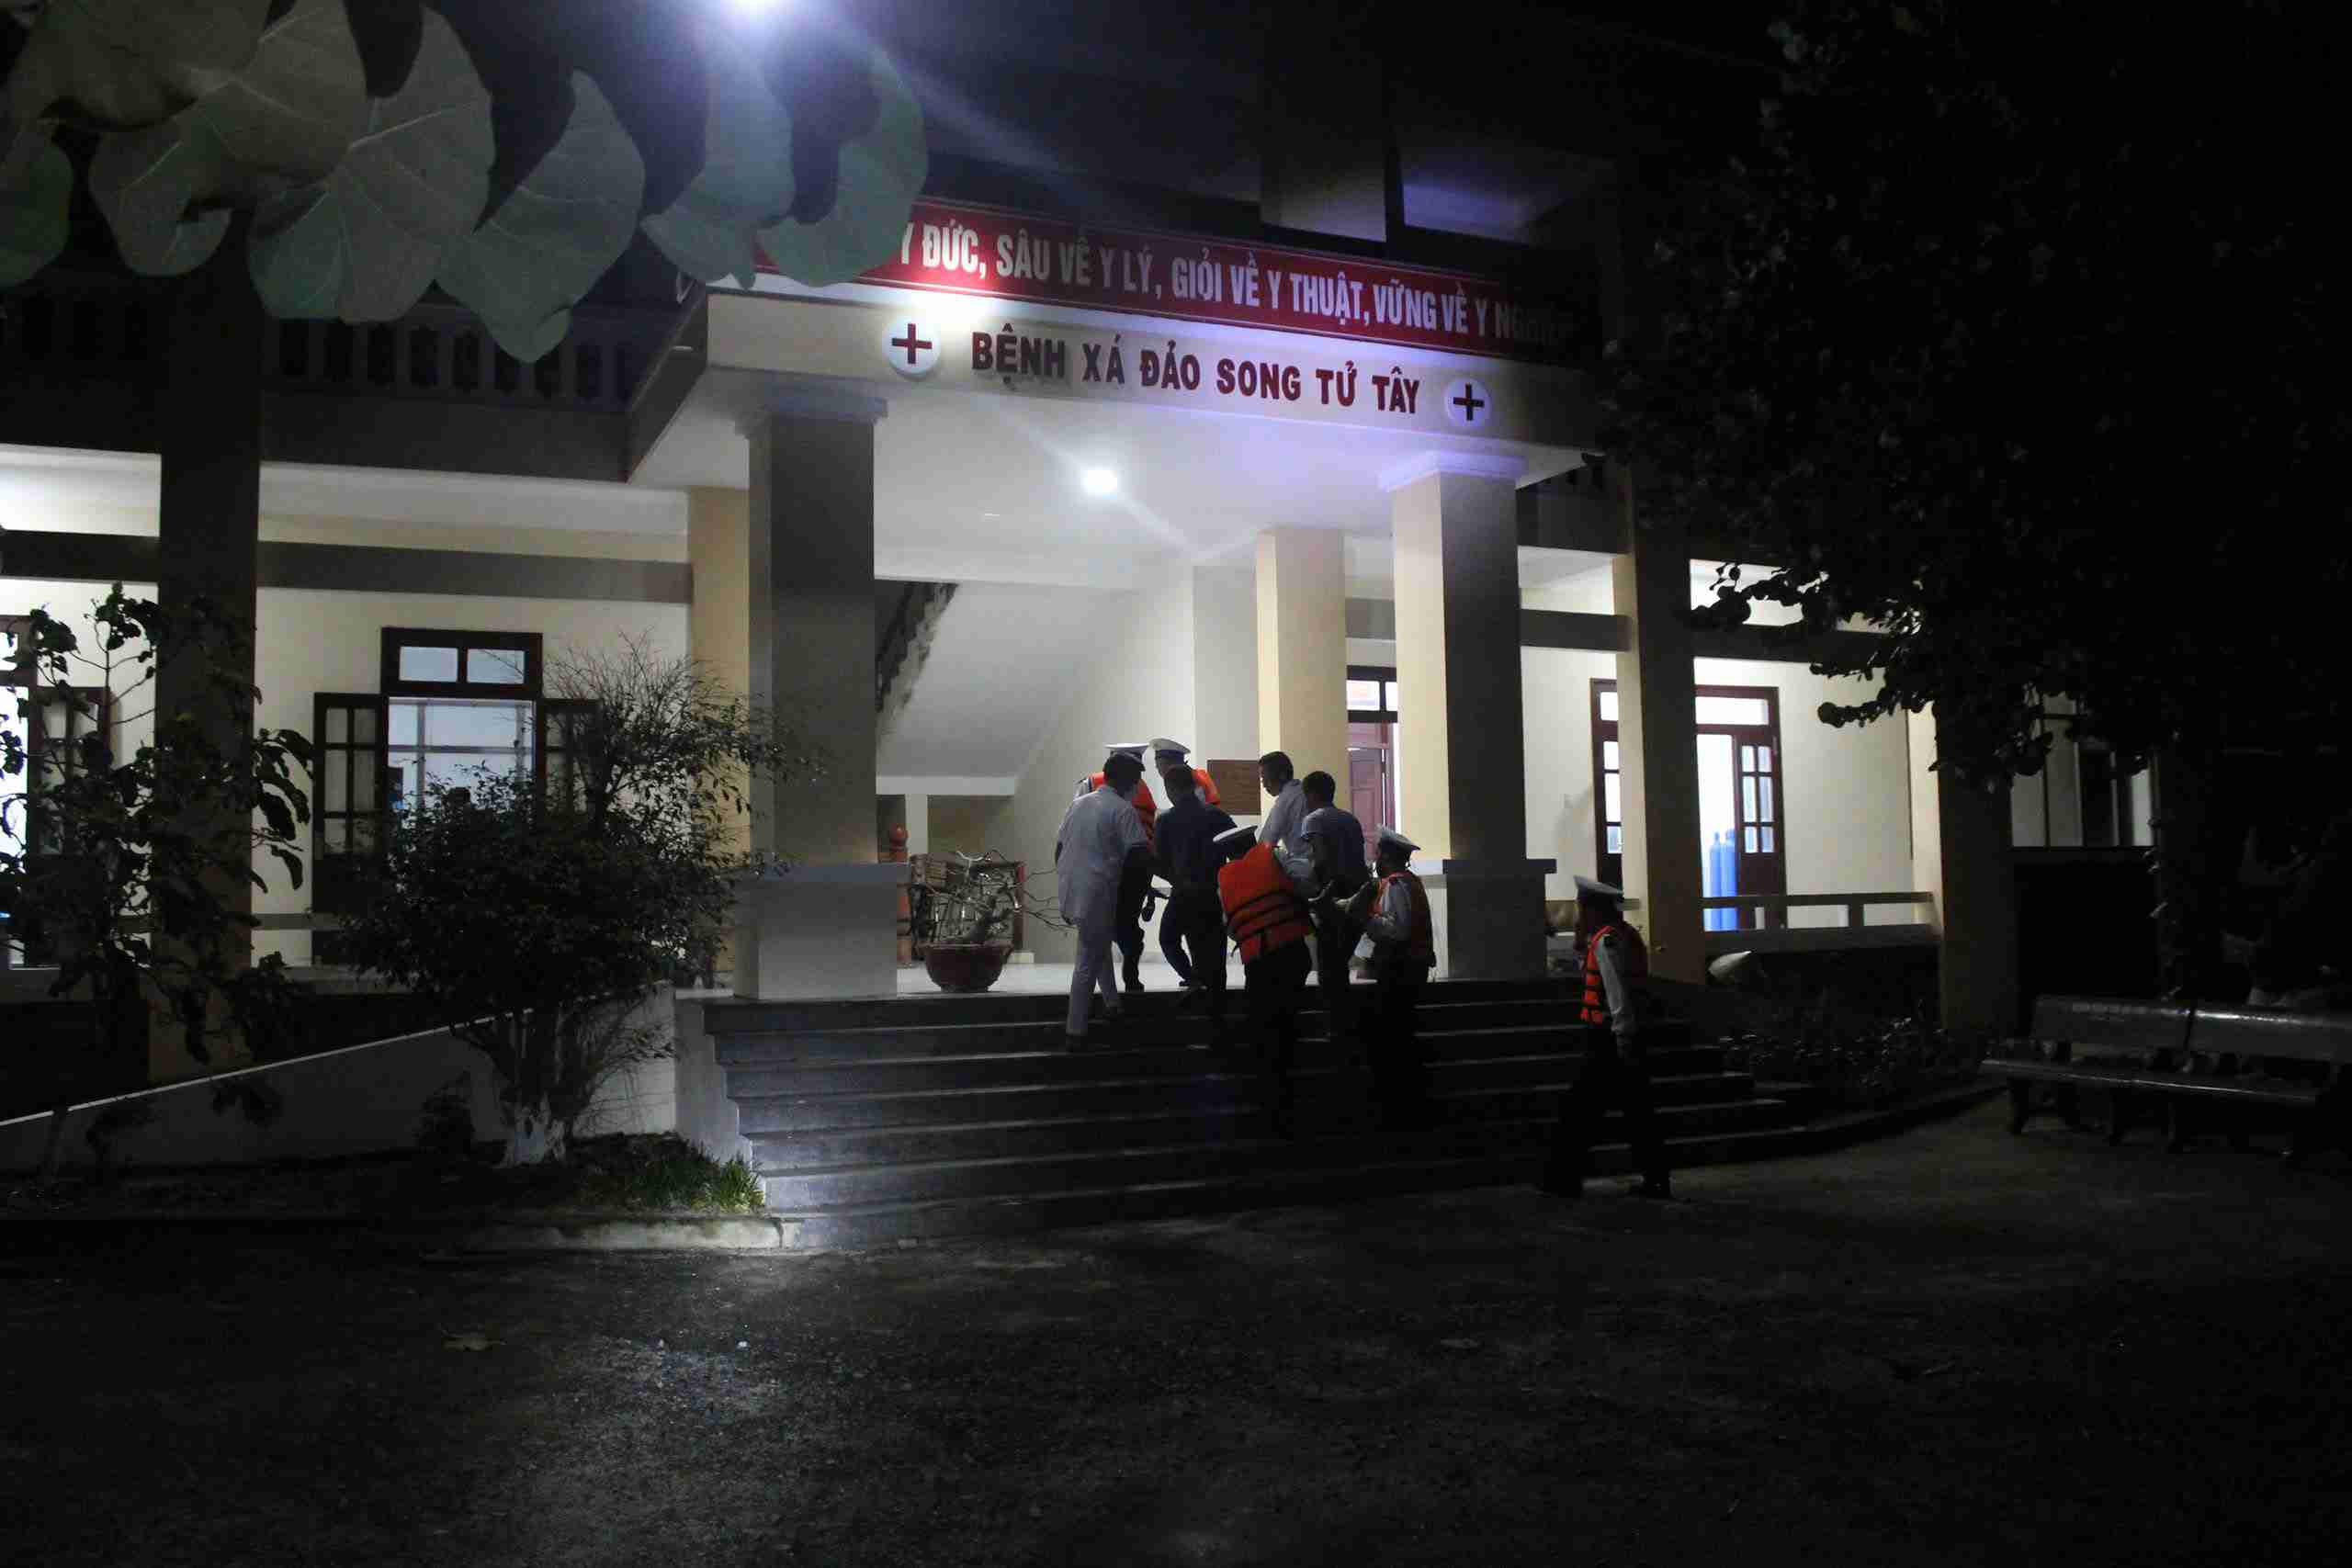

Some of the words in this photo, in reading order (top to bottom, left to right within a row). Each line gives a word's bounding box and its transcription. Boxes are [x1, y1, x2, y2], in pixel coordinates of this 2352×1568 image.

[922, 220, 986, 278] ĐỨC,
[996, 228, 1051, 280] SÂU
[1100, 245, 1116, 288] Y
[1124, 244, 1161, 299] LÝ,
[1171, 246, 1223, 302] GIỎI
[1231, 249, 1260, 307] VỀ
[1267, 270, 1282, 309] Y
[1289, 271, 1370, 326] THUẬT,
[1373, 279, 1437, 331] VỮNG
[1442, 280, 1469, 334] VỀ
[1475, 298, 1487, 337] Y
[971, 322, 1066, 384] BỆNH
[1082, 333, 1125, 385] XÁ
[1139, 340, 1201, 390] ĐẢO
[1216, 358, 1301, 401] SONG
[1316, 360, 1358, 407] TỬ
[1372, 366, 1420, 414] TÂY
